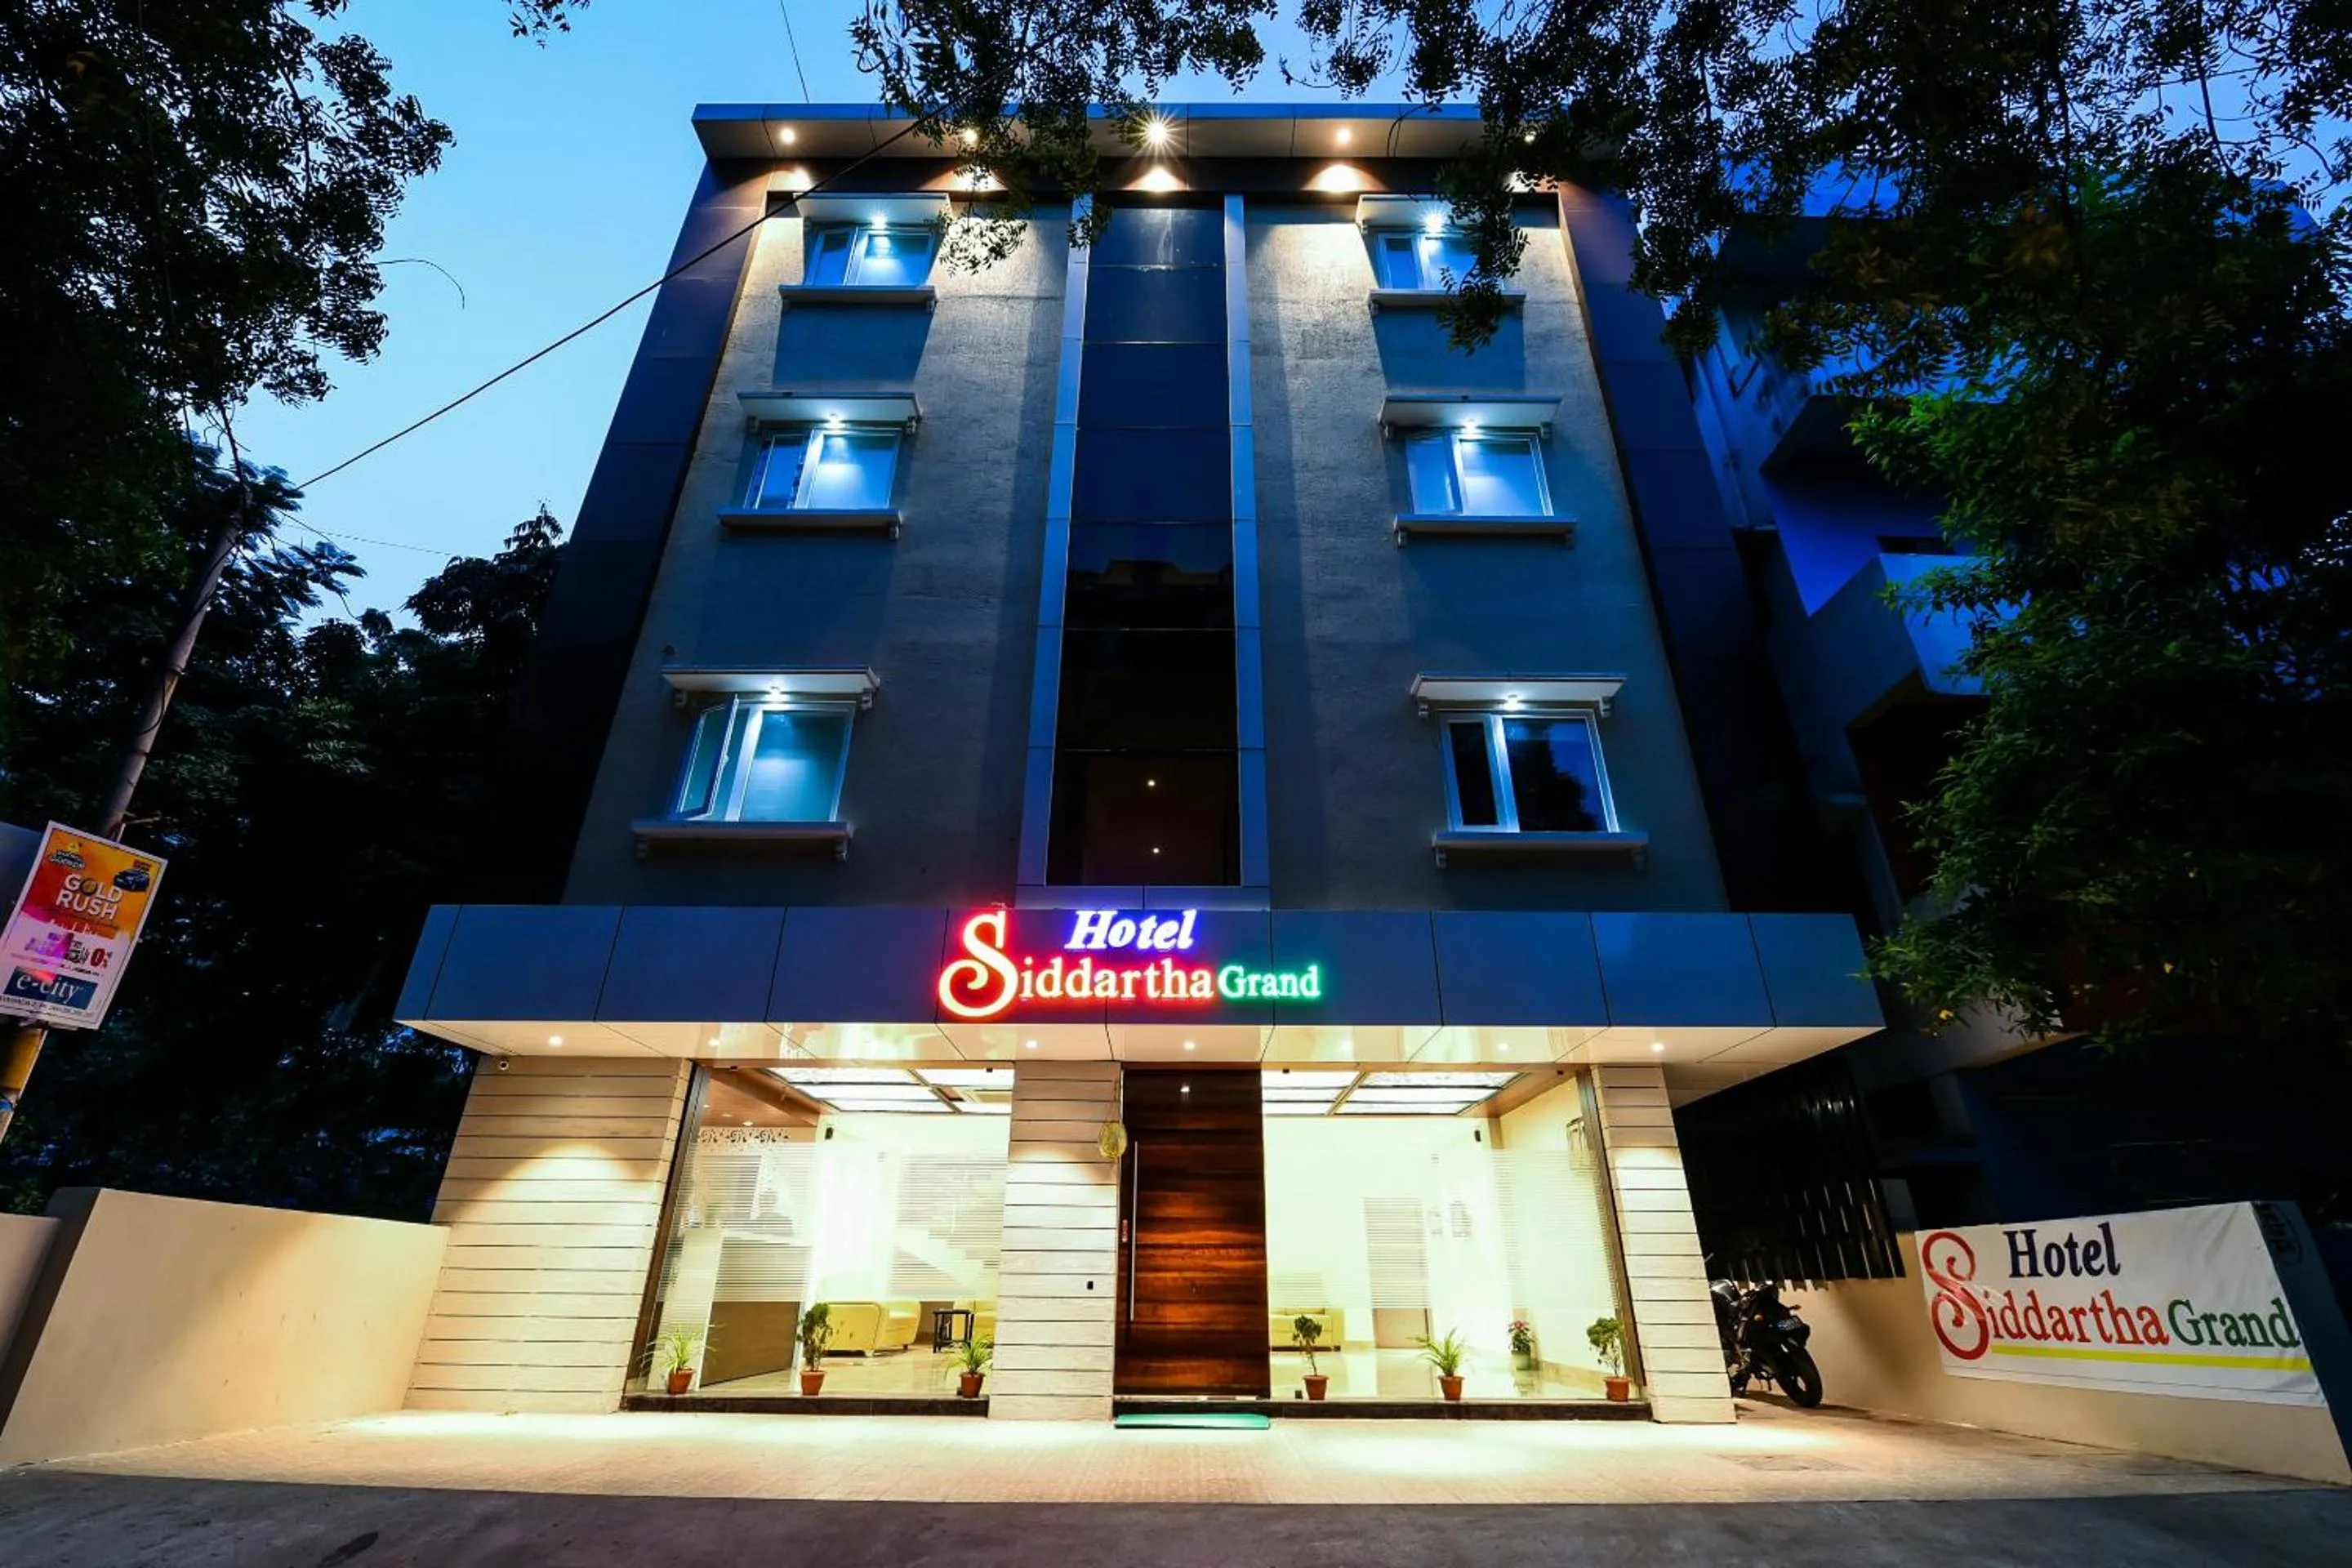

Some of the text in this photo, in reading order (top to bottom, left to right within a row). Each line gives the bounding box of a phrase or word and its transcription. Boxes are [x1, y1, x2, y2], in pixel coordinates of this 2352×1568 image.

[56, 890, 119, 920] RUSH
[65, 873, 122, 902] GOLD
[1064, 908, 1197, 951] Hotel
[938, 910, 1321, 1018] Siddartha Grand
[2003, 1223, 2122, 1278] Hotel
[1922, 1232, 2169, 1361] Siddartha
[2167, 1298, 2301, 1348] Grand
